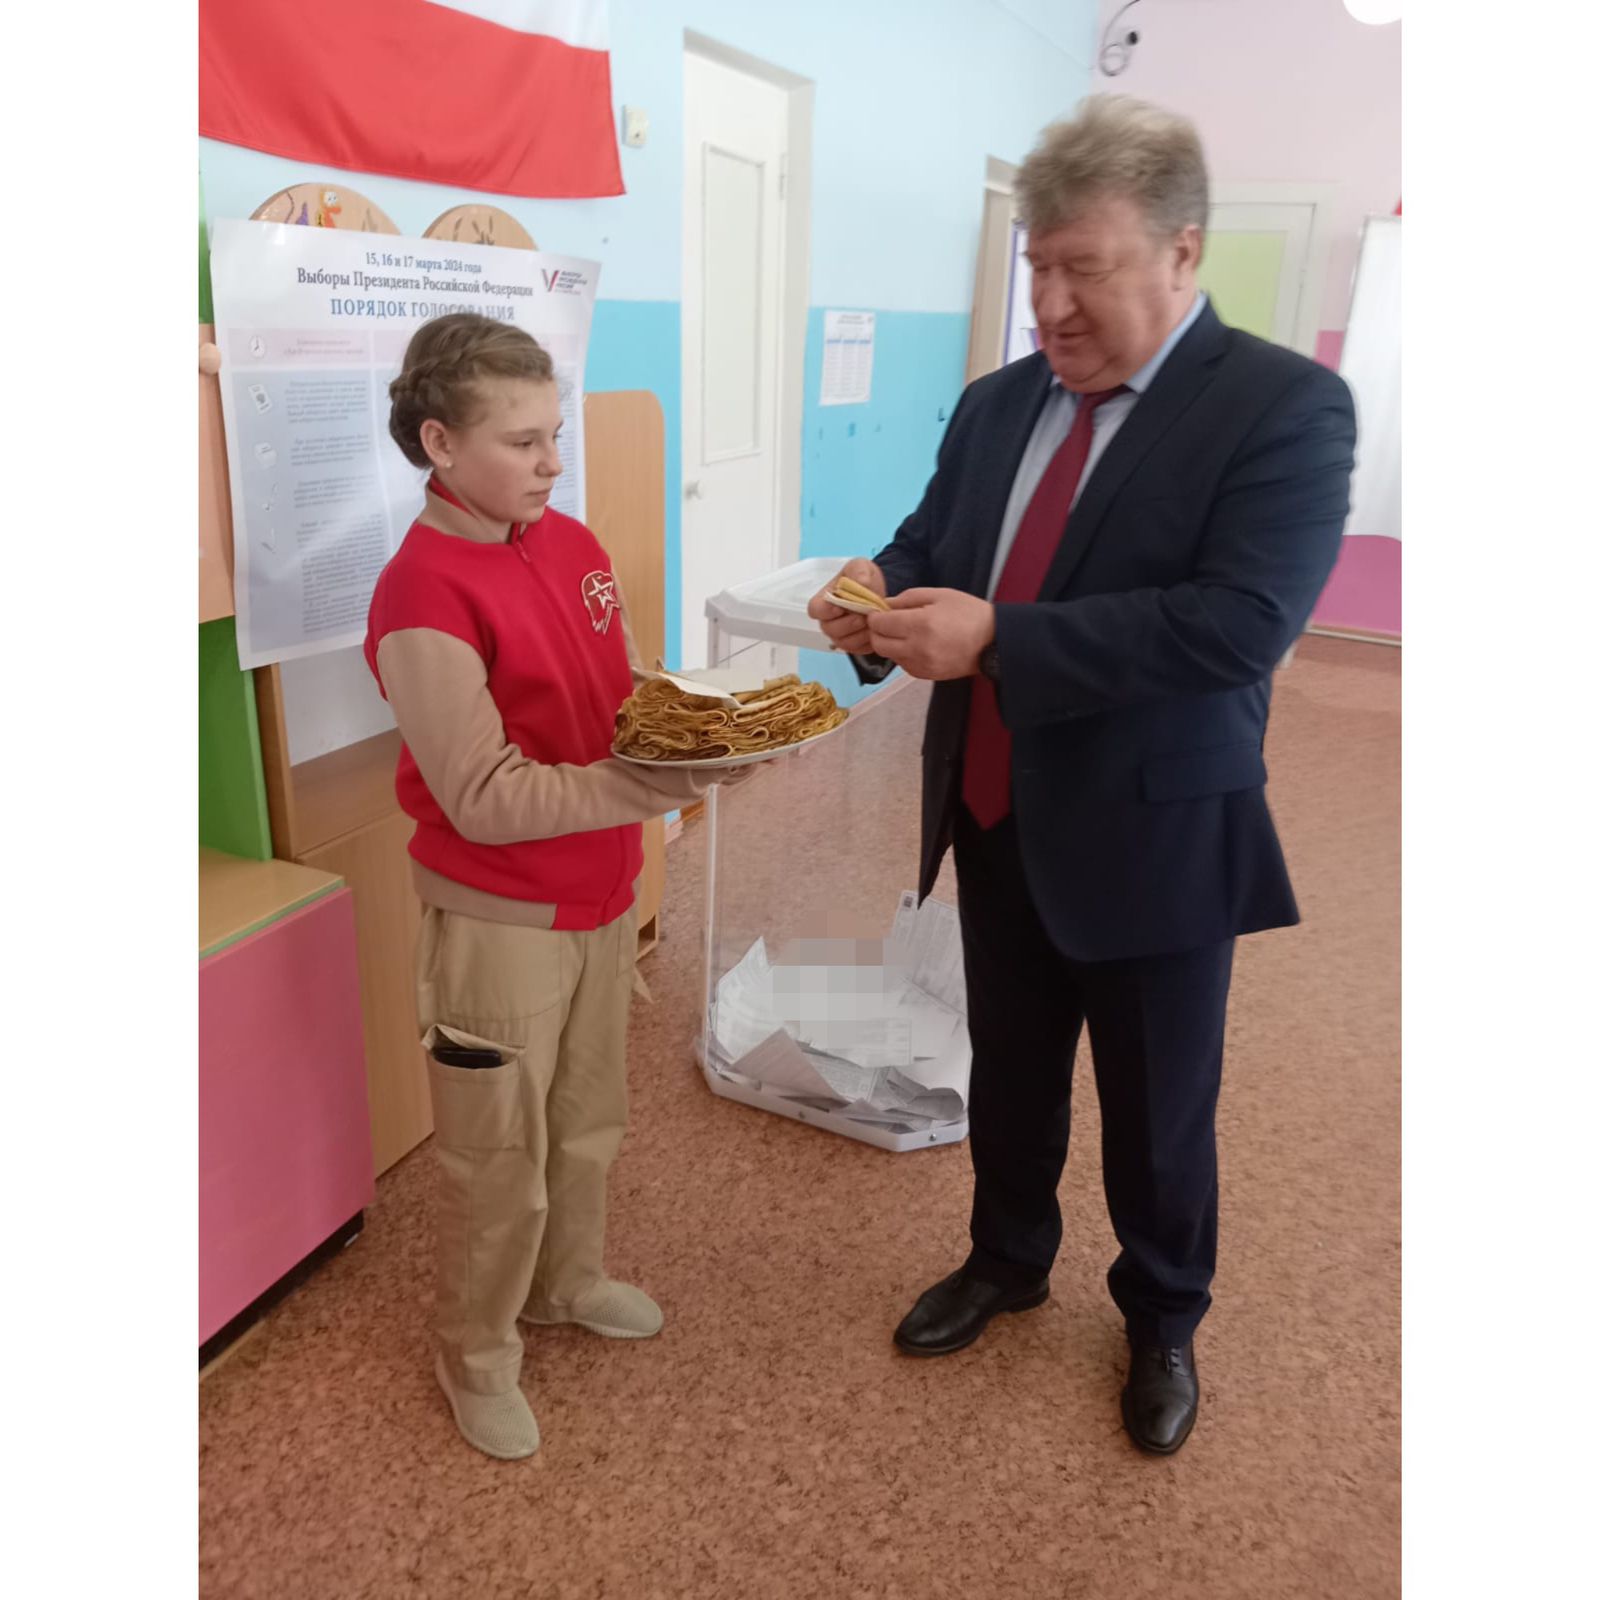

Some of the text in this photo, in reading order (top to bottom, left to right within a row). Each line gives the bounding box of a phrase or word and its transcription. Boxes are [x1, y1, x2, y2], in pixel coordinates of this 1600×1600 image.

[366, 252, 482, 274] 15, 16 и 17 марта 2024 года
[297, 267, 533, 299] Выборы Президента Российской Федерации
[331, 298, 407, 319] ПОРЯДОК
